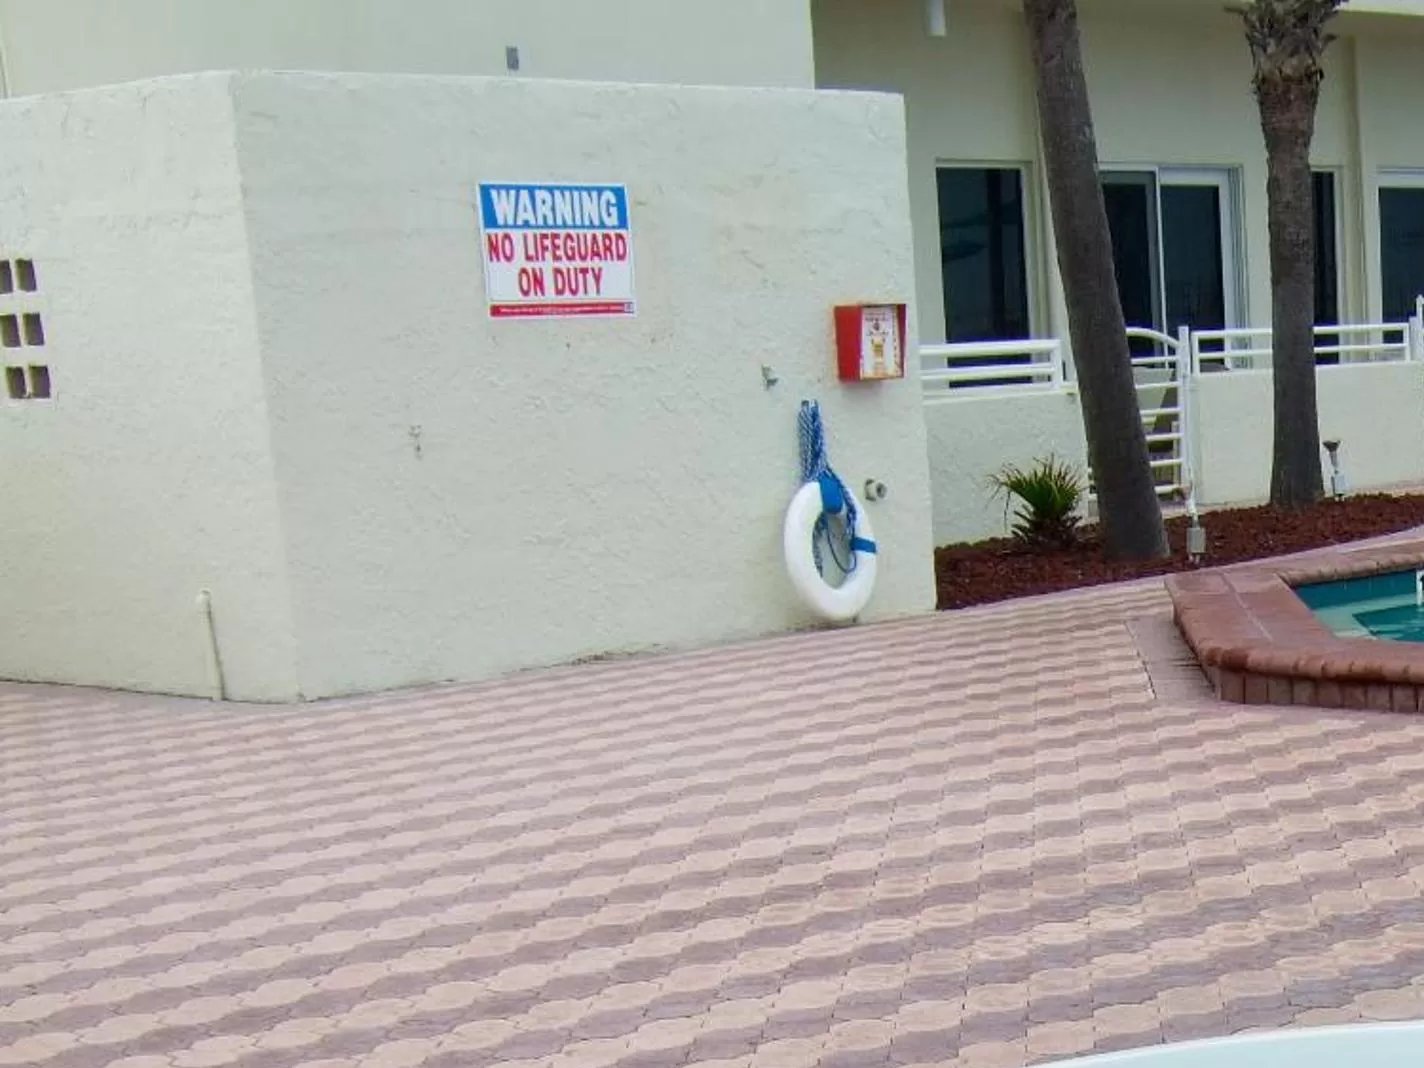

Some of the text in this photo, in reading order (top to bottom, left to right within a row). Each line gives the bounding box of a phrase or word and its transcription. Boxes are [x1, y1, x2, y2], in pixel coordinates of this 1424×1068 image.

[489, 188, 619, 227] WARNING
[487, 232, 627, 262] NO LIFEGUARD
[518, 267, 602, 297] ON DUTY
